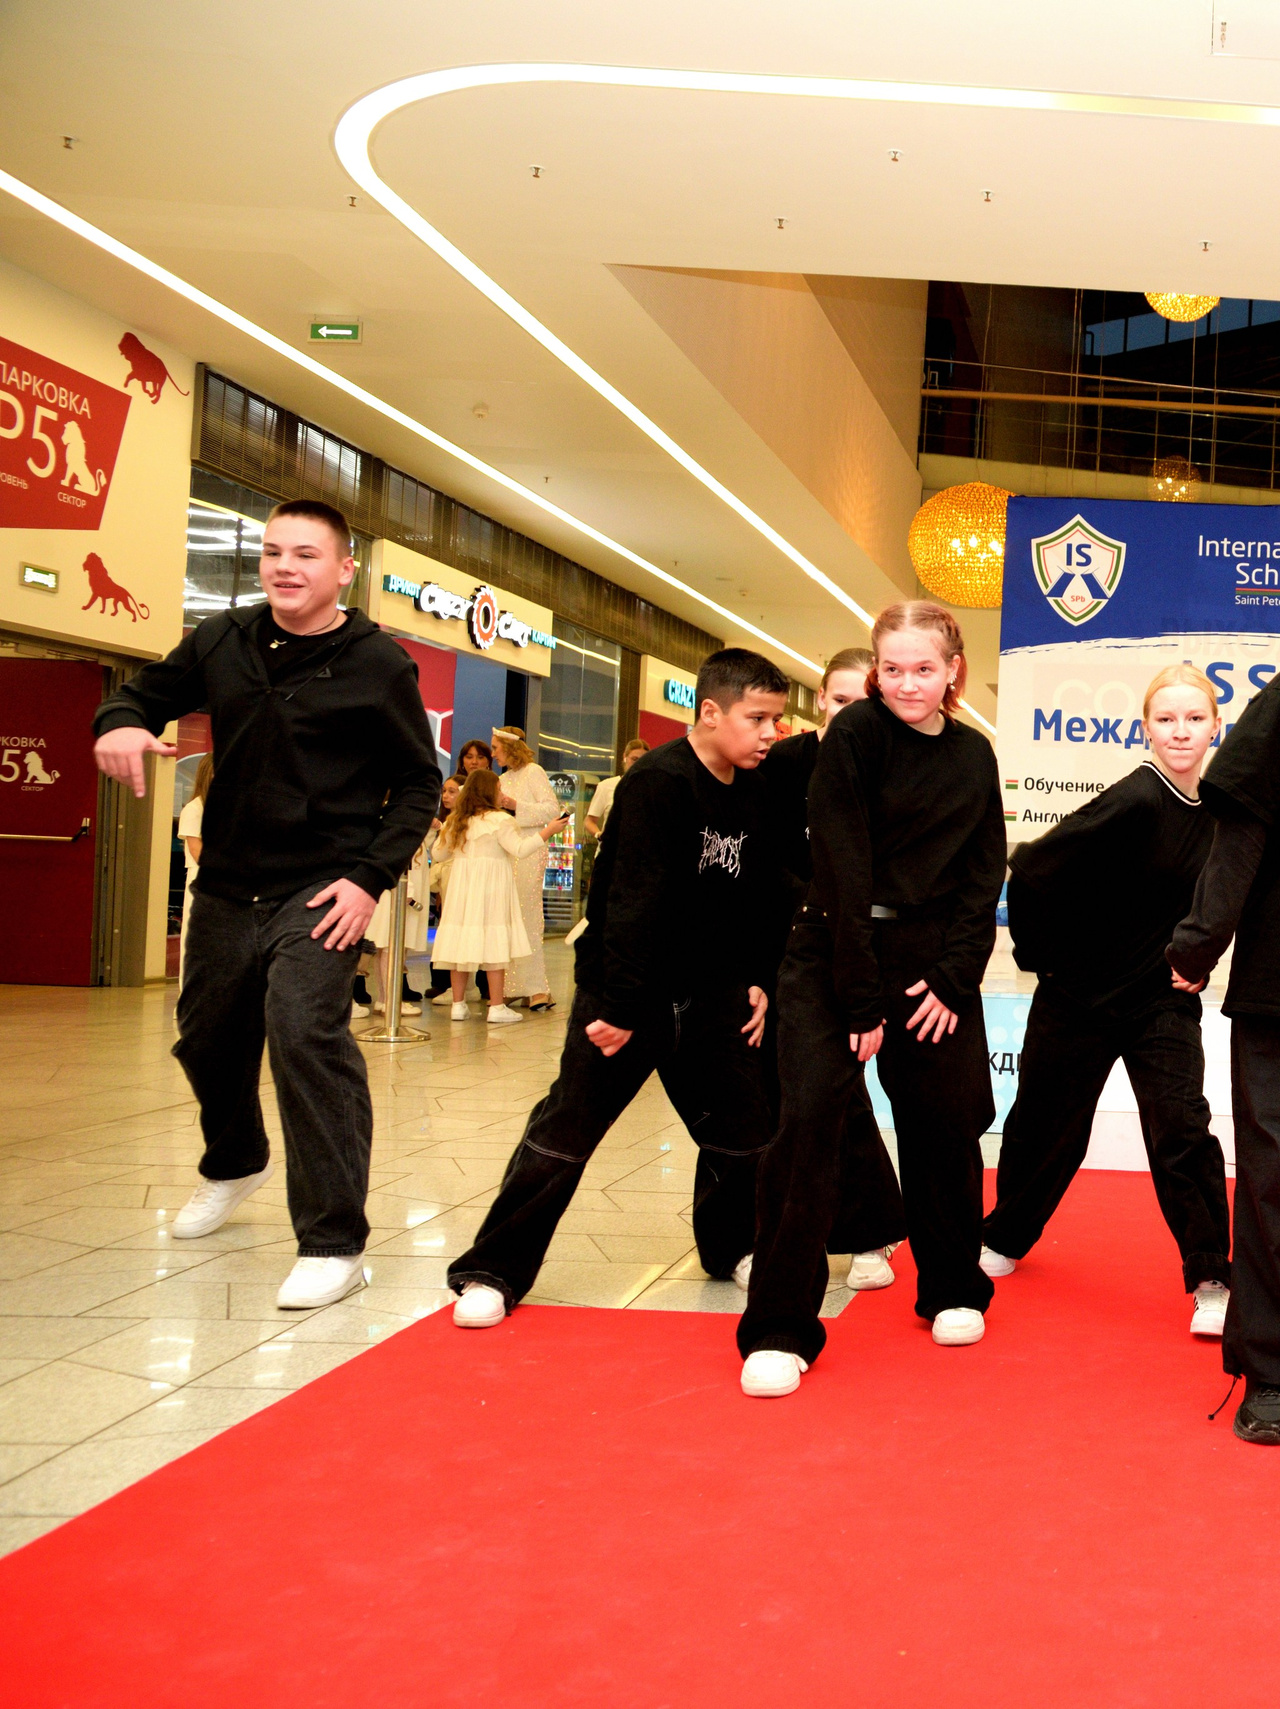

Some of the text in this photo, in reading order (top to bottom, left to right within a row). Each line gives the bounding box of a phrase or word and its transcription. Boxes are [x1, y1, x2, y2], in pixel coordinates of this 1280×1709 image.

[0, 471, 29, 490] ОВЕНЬ
[57, 491, 87, 509] СЕКТОР
[1066, 543, 1092, 567] IS
[1235, 595, 1259, 605] Saint
[0, 736, 47, 748] КОВКА
[1024, 777, 1105, 794] Обучение
